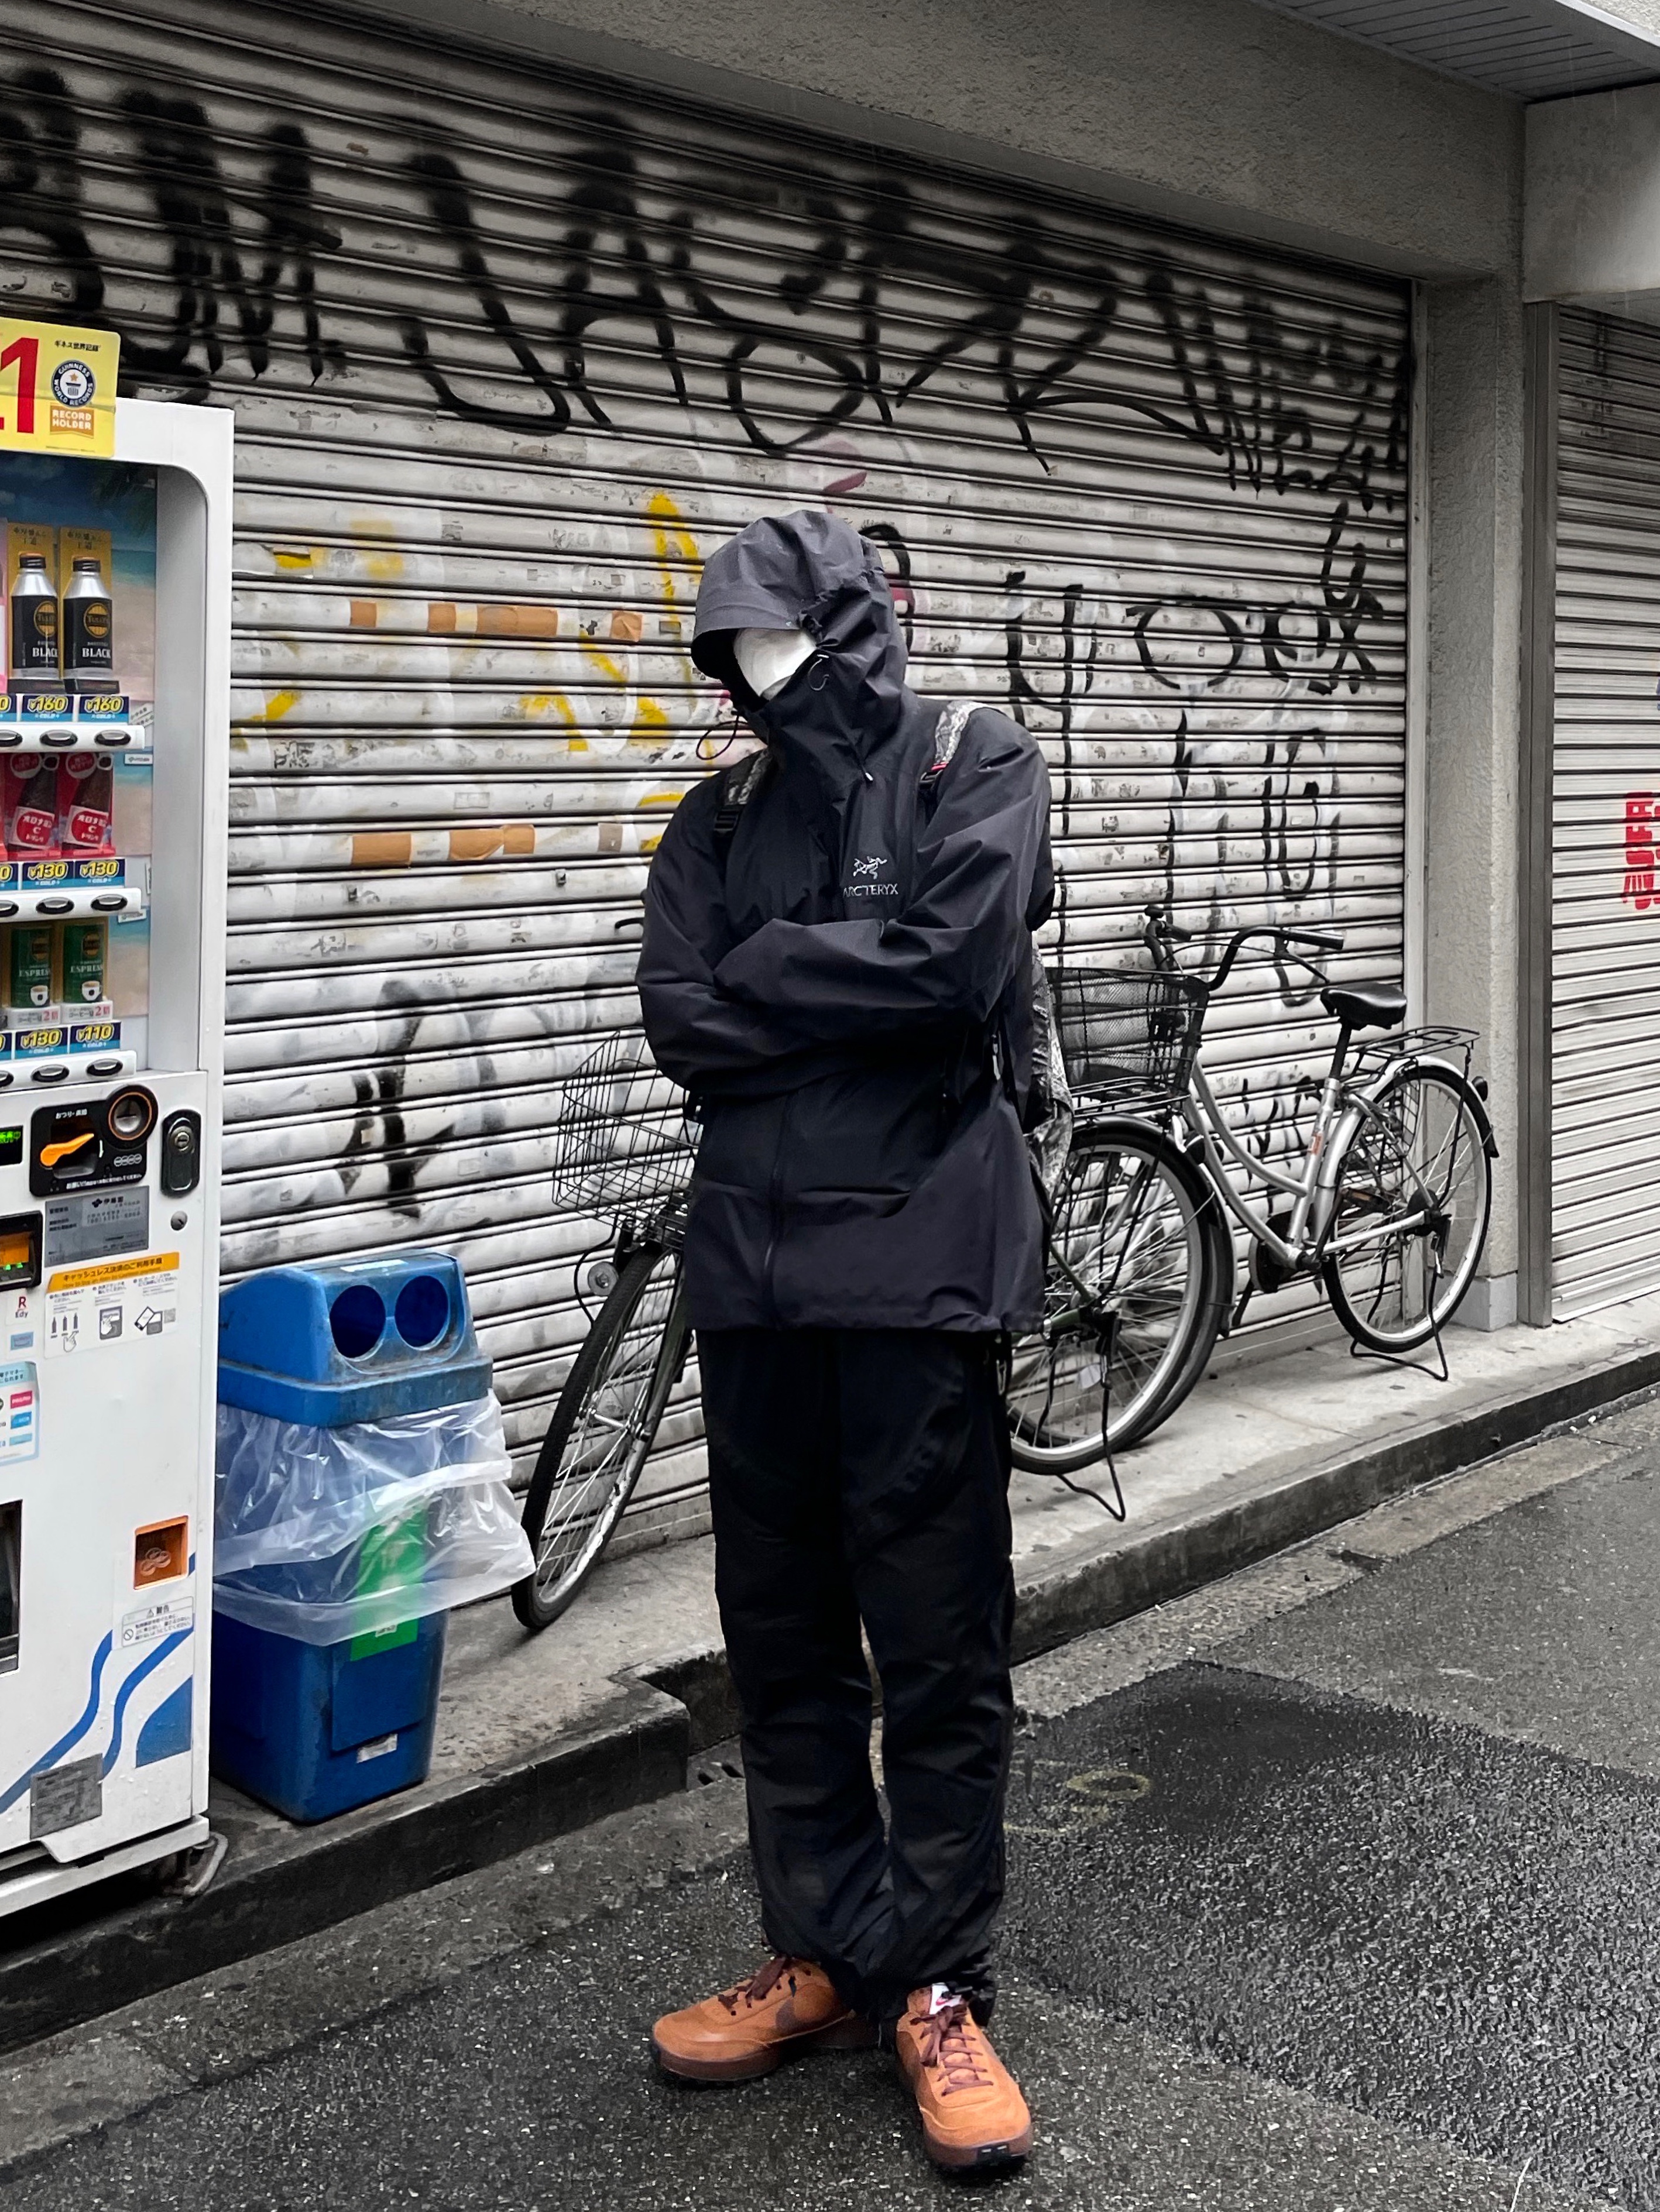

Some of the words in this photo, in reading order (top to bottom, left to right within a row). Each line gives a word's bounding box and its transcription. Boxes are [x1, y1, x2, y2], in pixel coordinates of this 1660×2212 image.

[57, 361, 91, 377] GUINNESS
[54, 379, 68, 404] WORLD
[69, 382, 94, 406] RECORDS
[52, 409, 92, 421] RECORD
[52, 418, 91, 430] HOLDER
[82, 647, 111, 659] BLACK
[29, 696, 67, 712] ¥160
[85, 696, 124, 712] ¥160
[29, 862, 67, 879] ¥130
[81, 861, 118, 877] ¥130
[22, 1029, 60, 1047] ¥130
[77, 1024, 114, 1041] ¥110
